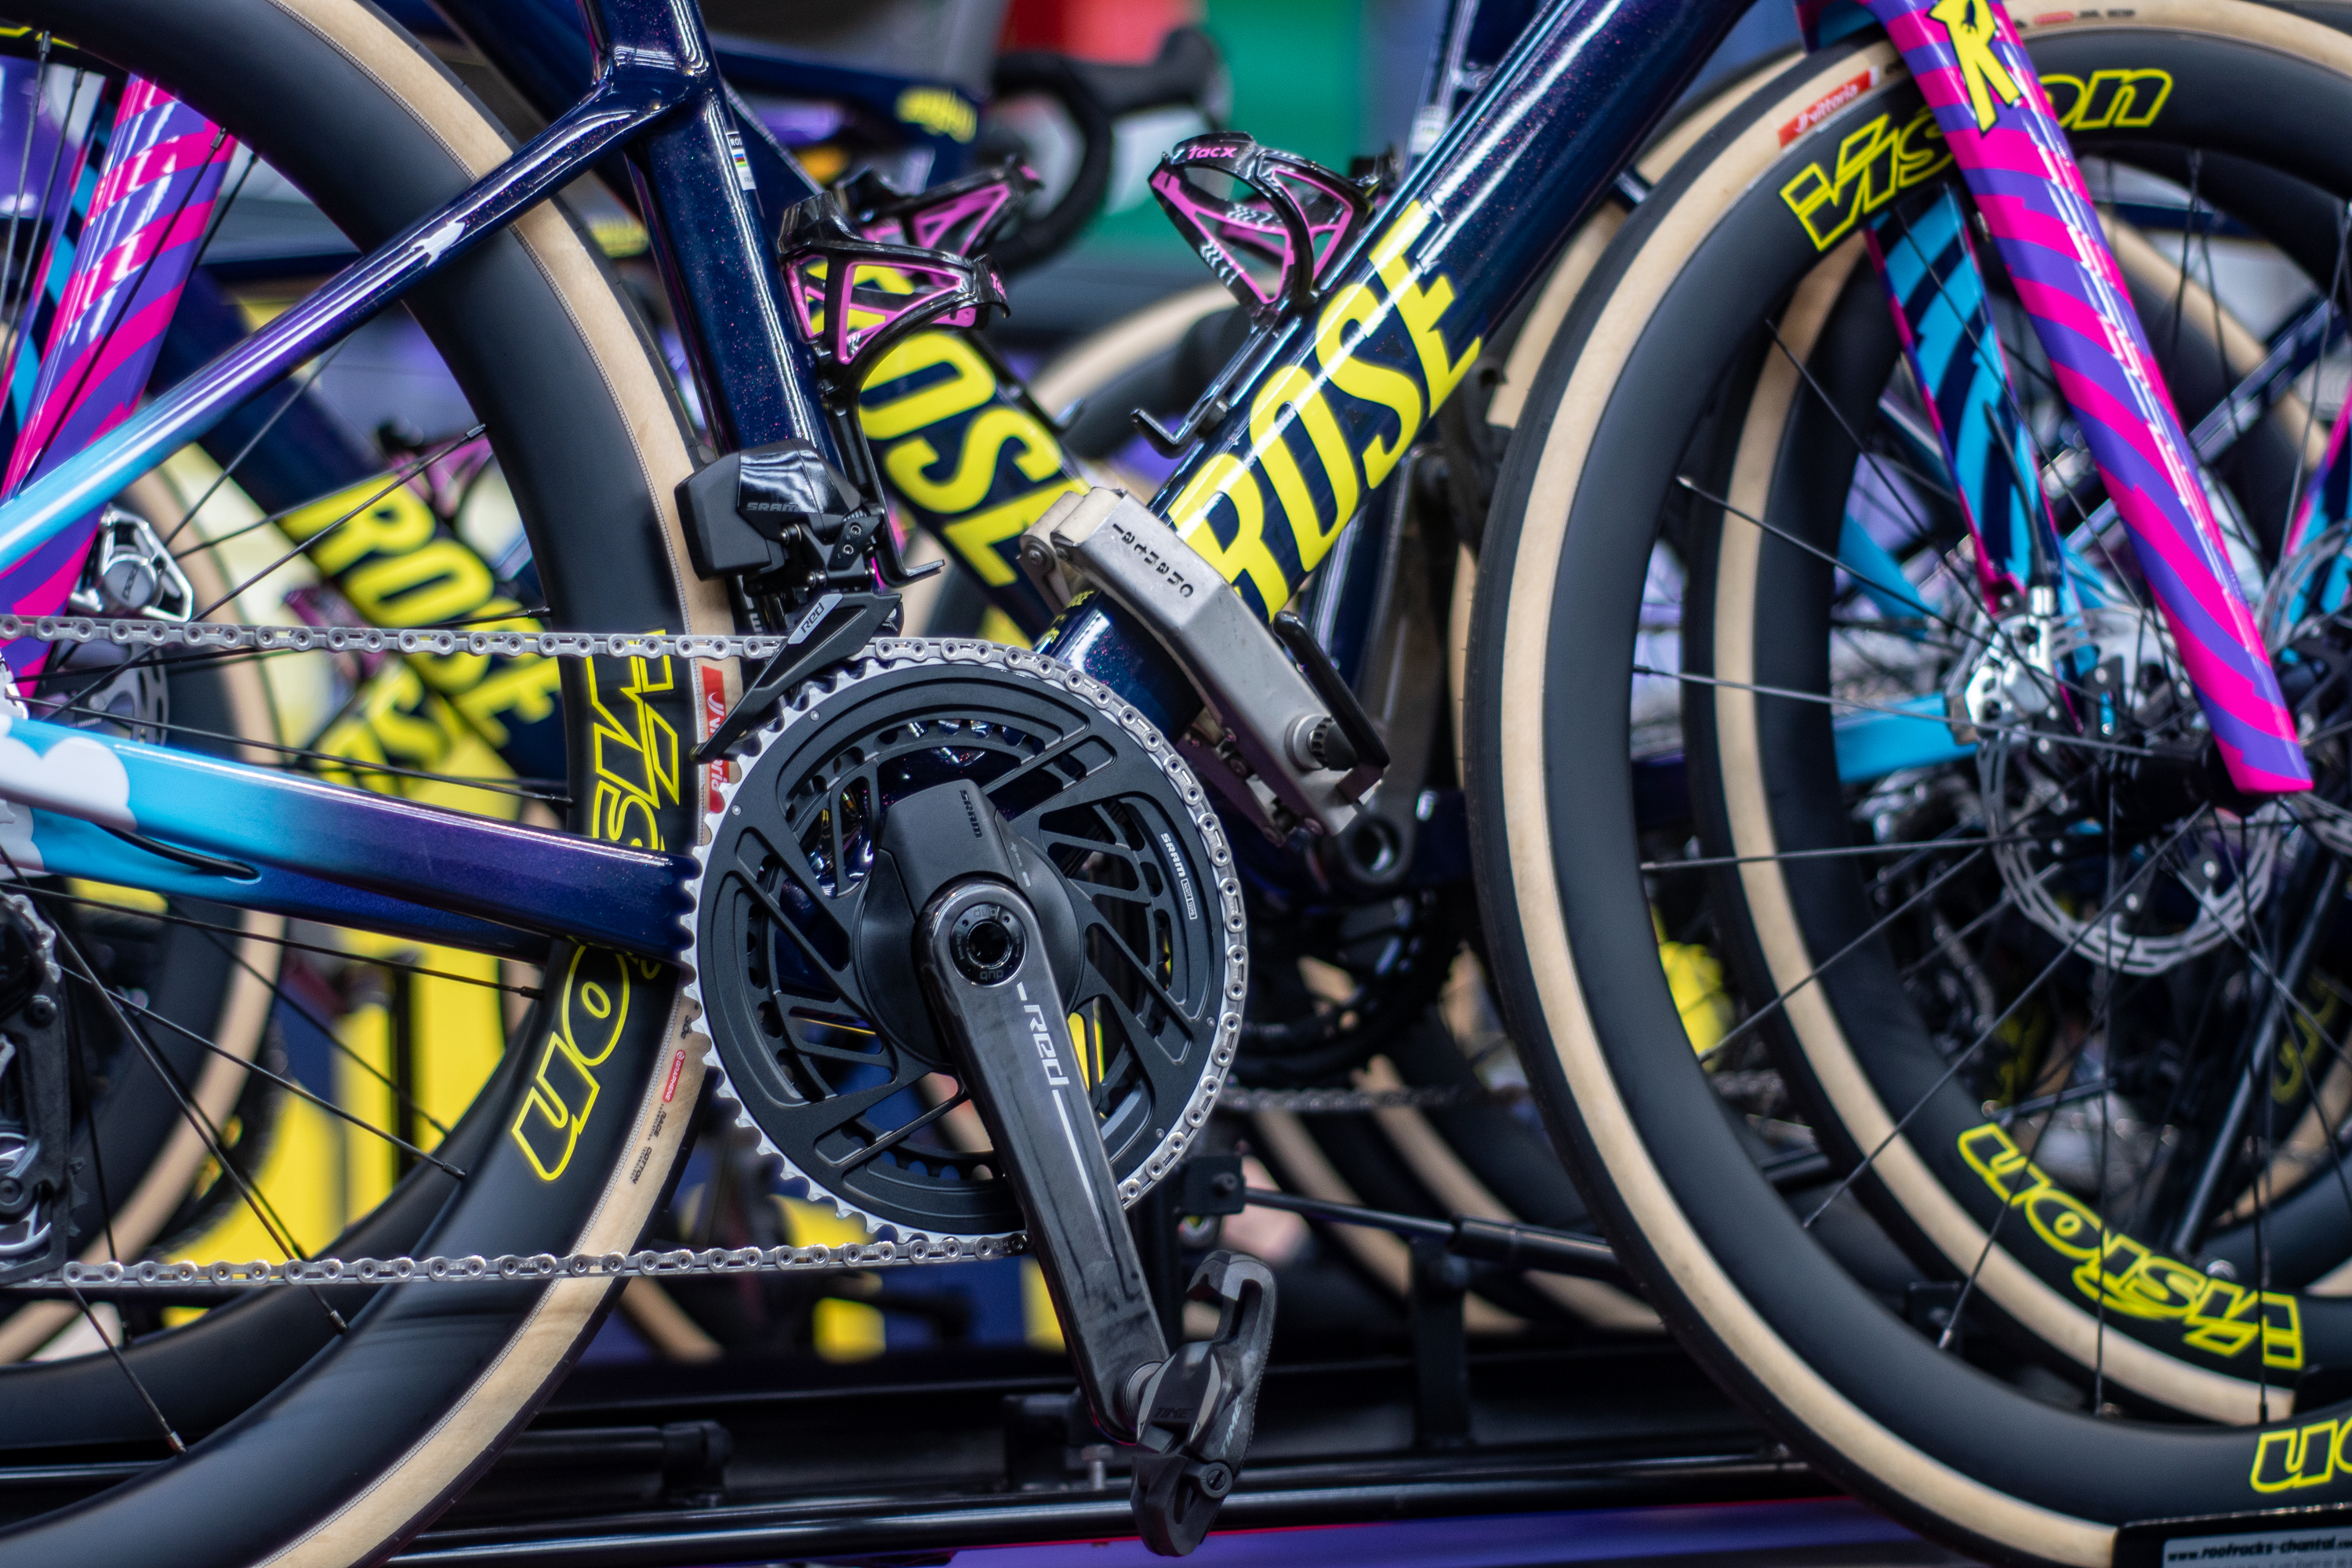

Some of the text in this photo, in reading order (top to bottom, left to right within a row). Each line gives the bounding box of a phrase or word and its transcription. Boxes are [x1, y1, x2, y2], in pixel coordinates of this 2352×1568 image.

[1780, 68, 2173, 251] Vison
[1167, 199, 1483, 623] ROSE
[746, 502, 800, 511] SRAM
[1112, 522, 1195, 599] Chantal
[959, 789, 983, 839] SRAM
[1160, 833, 1186, 878] SRAM
[665, 1060, 682, 1101] GRAPHENE
[653, 1110, 667, 1138] RACE
[632, 1146, 652, 1185] COTTON
[1154, 1406, 1193, 1419] TIME
[1220, 1396, 1243, 1457] TIME
